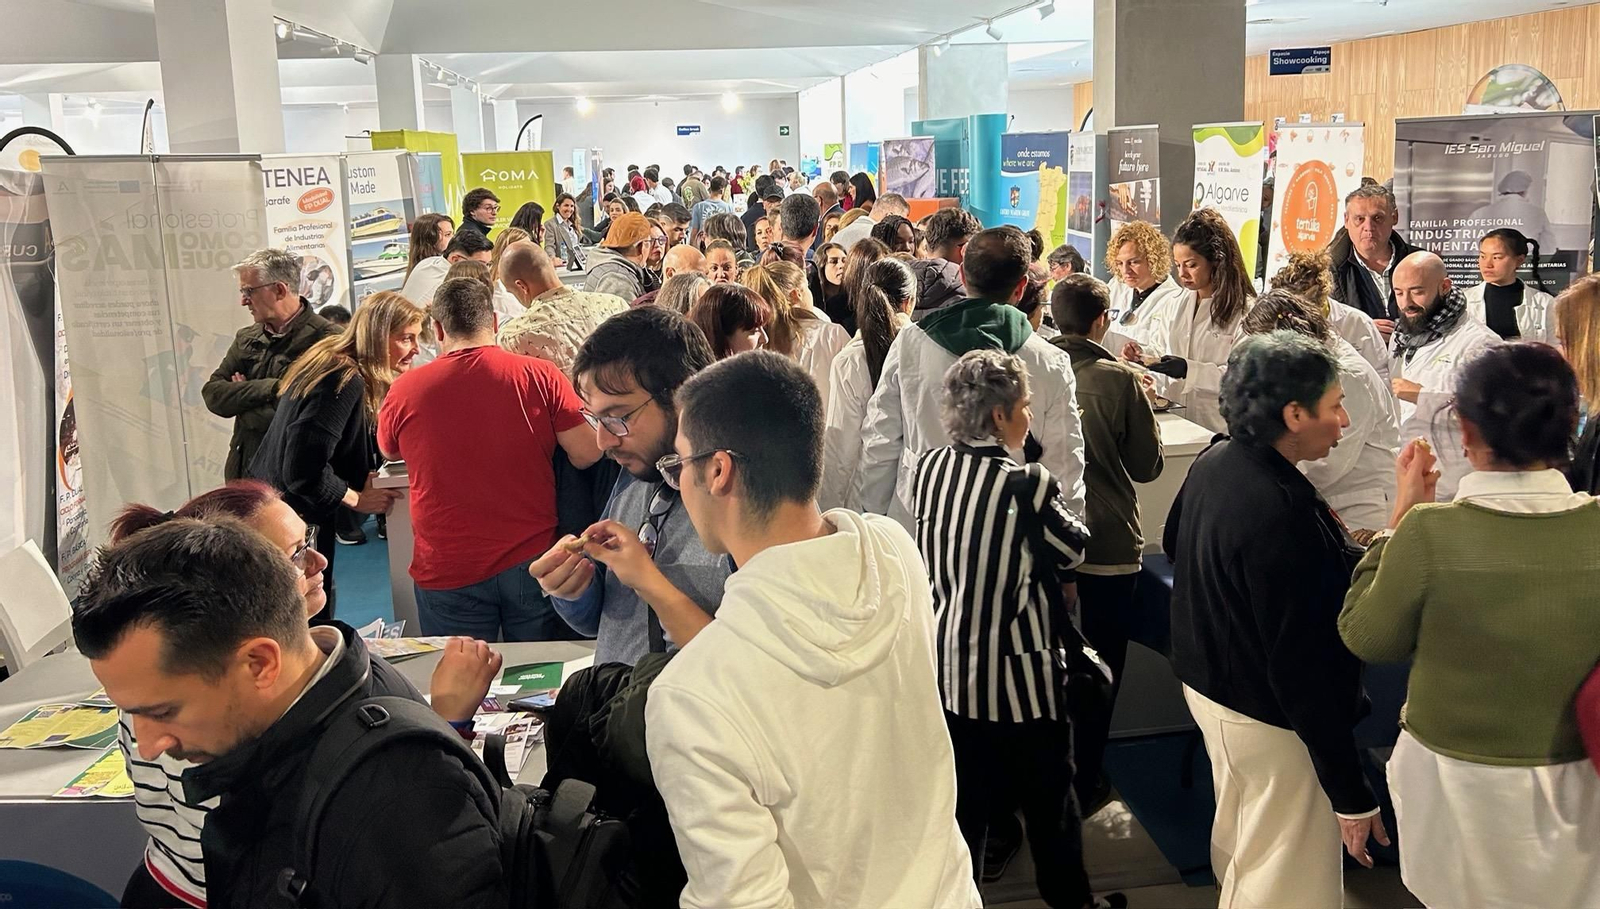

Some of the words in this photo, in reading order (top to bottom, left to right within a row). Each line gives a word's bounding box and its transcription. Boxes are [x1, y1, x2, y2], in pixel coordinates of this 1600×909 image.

[1273, 56, 1328, 65] Showcooking
[1017, 148, 1029, 158] onde
[1030, 150, 1050, 158] estamos
[1444, 144, 1466, 154] IES
[1468, 143, 1496, 154] San
[1499, 140, 1546, 154] Miguel
[1003, 158, 1016, 167] where
[1118, 159, 1135, 175] future
[1136, 159, 1150, 175] here
[262, 166, 332, 188] TENEA
[350, 181, 376, 195] Made
[1206, 182, 1249, 204] Algarve
[274, 224, 297, 234] Familia
[298, 222, 332, 232] Profesional
[1296, 218, 1320, 232] tertúlia
[1410, 220, 1448, 228] FAMILIA
[1453, 218, 1524, 226] PROFESIONAL
[294, 232, 324, 241] Industrias
[286, 242, 326, 251] Alimentarias
